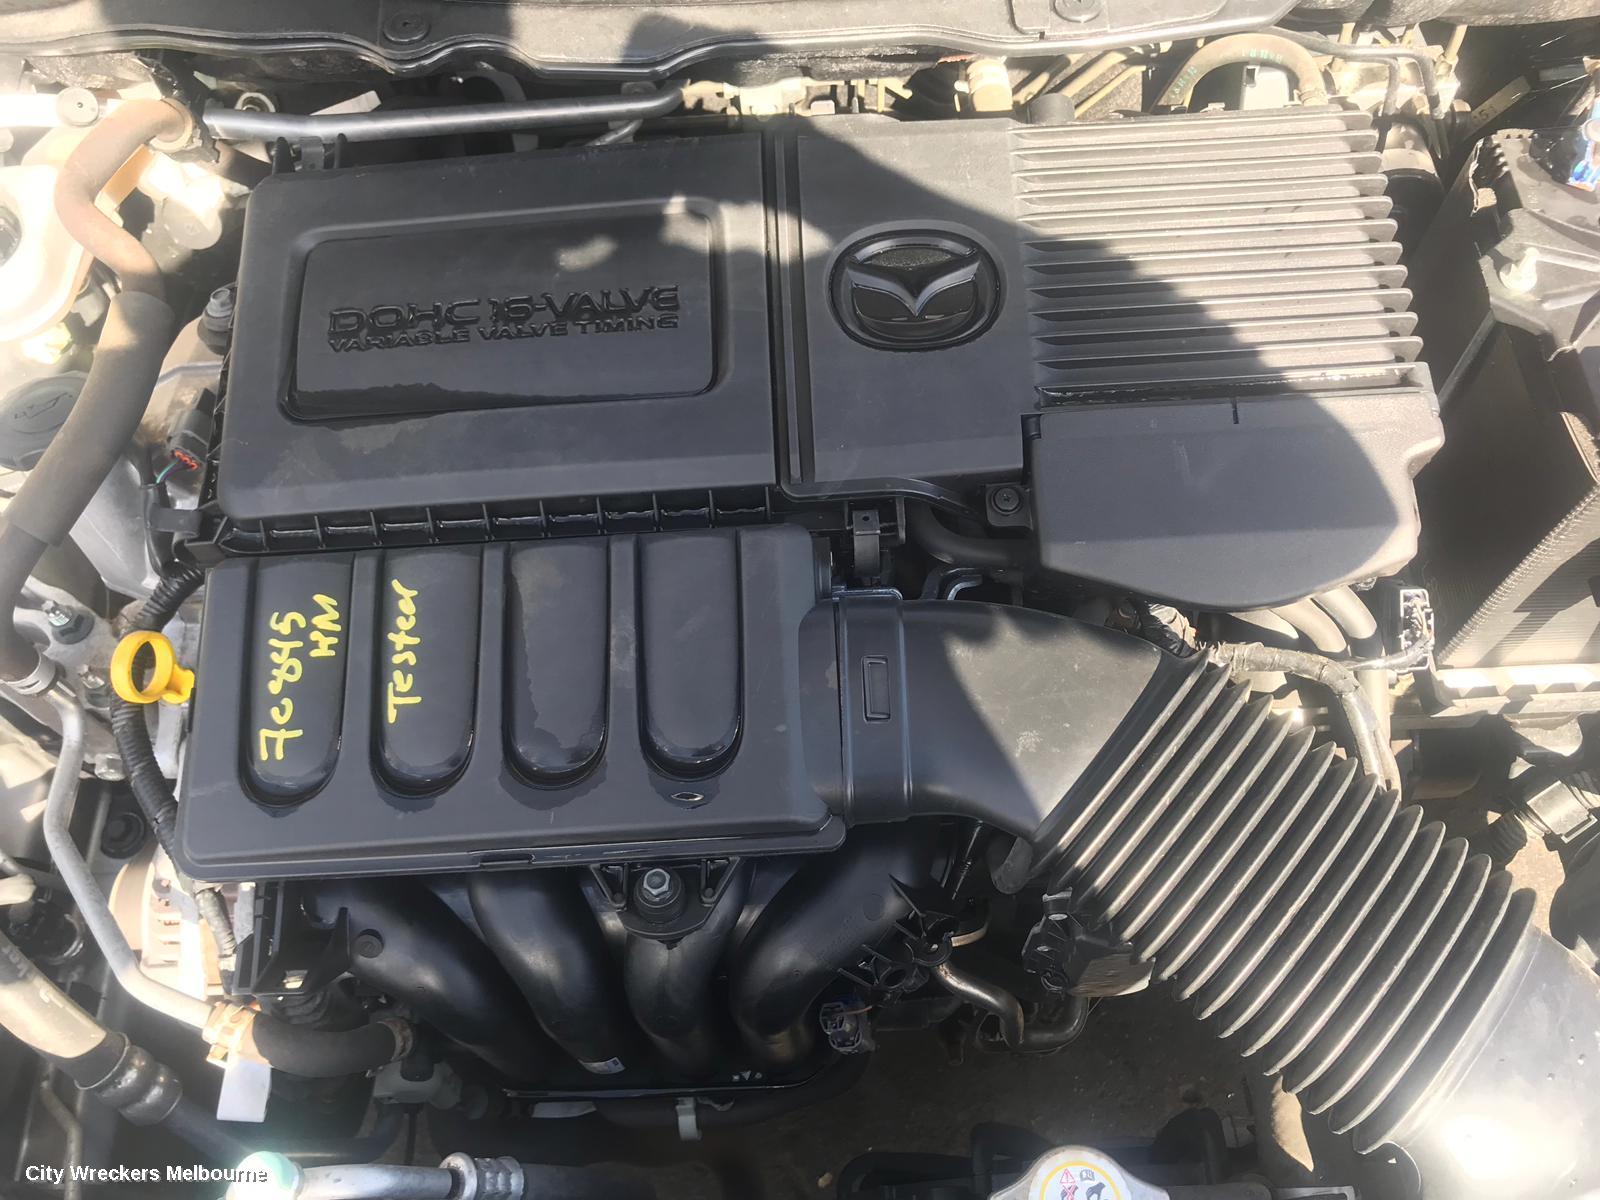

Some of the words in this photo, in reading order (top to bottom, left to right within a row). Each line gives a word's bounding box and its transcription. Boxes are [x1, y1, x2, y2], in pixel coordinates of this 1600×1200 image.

[329, 299, 480, 333] DOHC
[329, 330, 470, 353] VARIABLE
[479, 321, 568, 341] VALVE
[575, 314, 680, 334] TIMING
